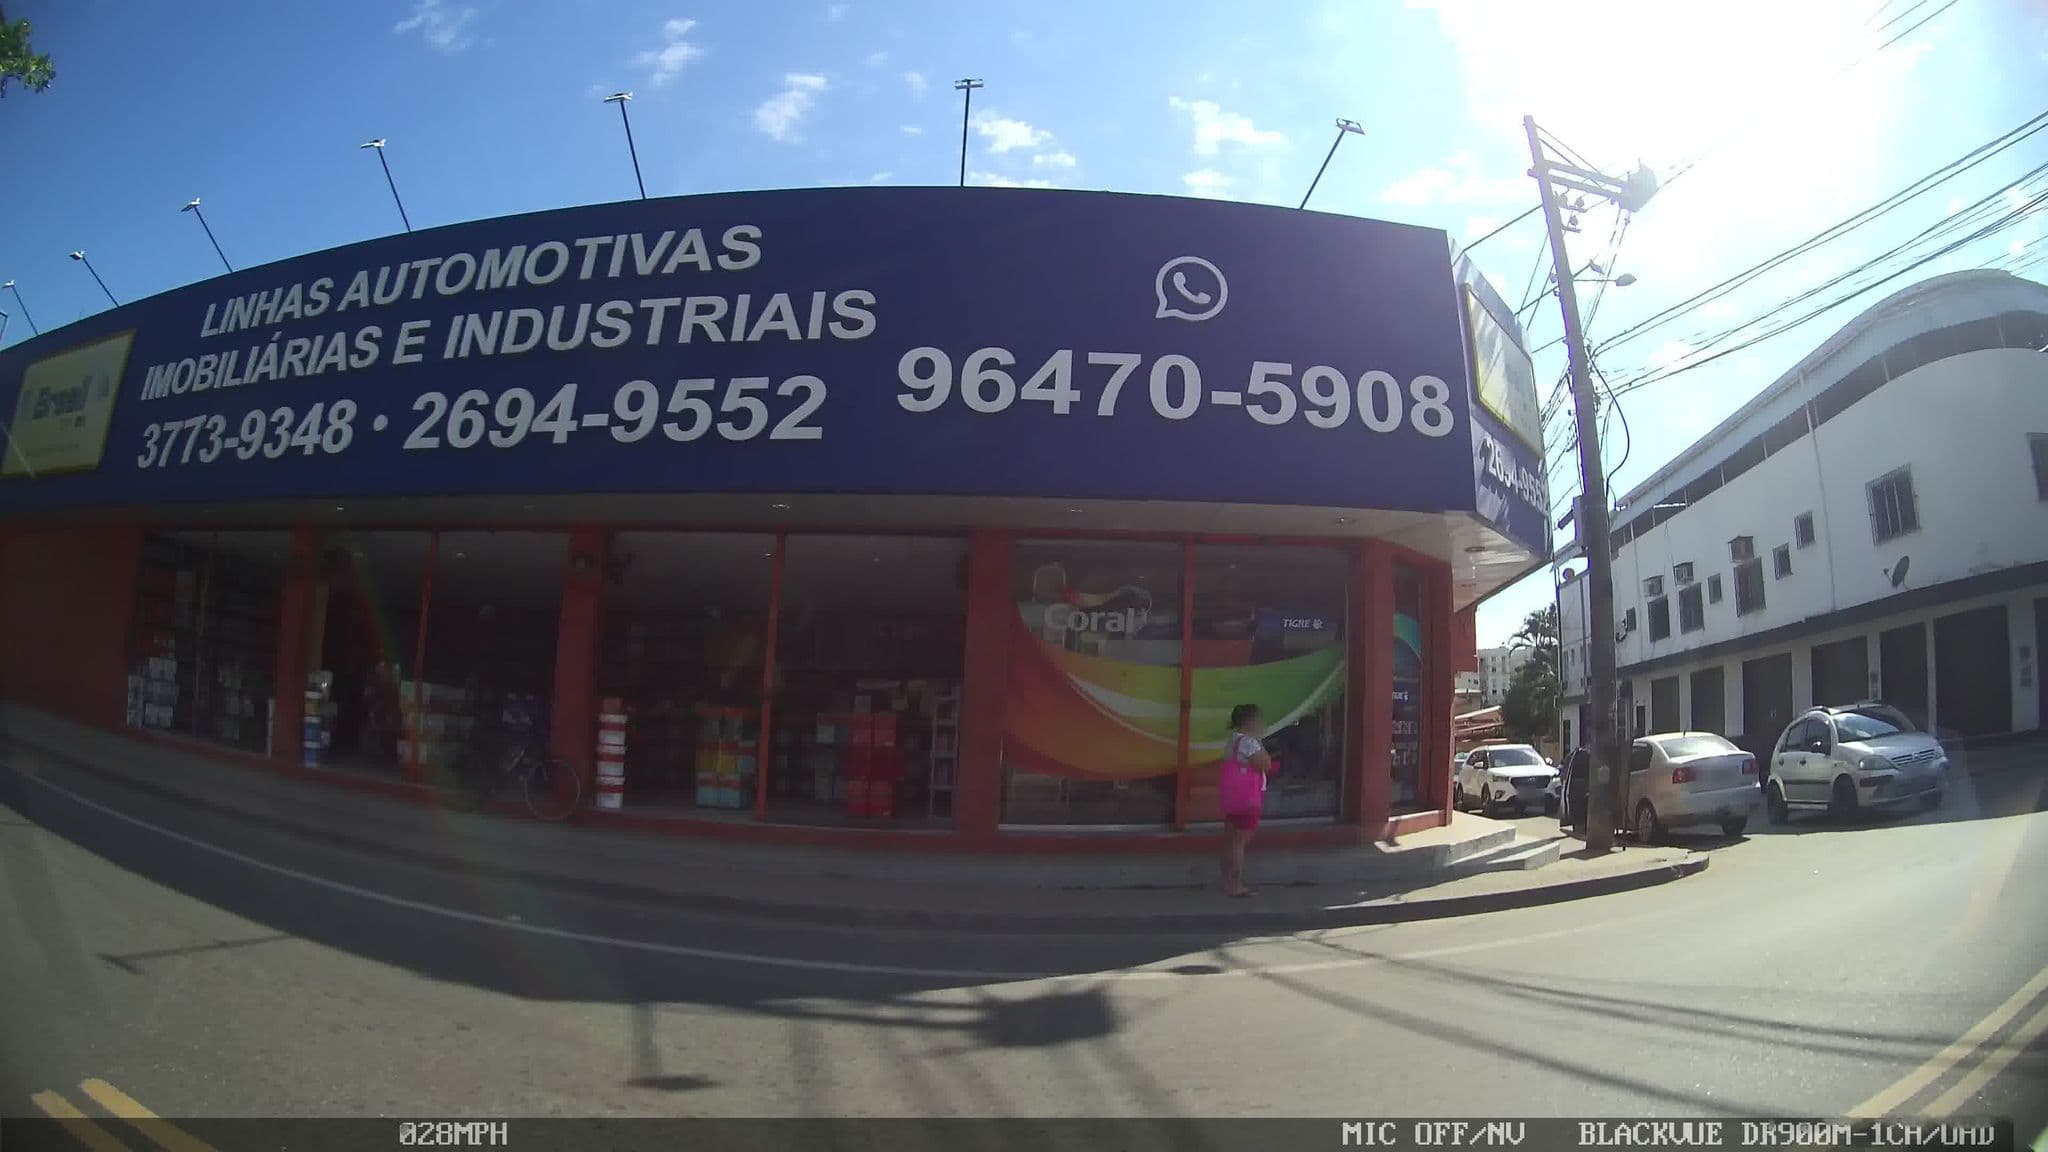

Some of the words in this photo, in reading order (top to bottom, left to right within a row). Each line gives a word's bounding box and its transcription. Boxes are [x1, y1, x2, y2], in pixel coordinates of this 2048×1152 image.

[200, 277, 333, 338] LINHAS
[337, 224, 763, 312] AUTOMOTIVAS
[140, 325, 382, 400] IMOBILIÁRIAS
[392, 319, 431, 365] E
[443, 289, 877, 360] INDUSTRIAIS
[138, 400, 357, 468] 3773-9348
[403, 375, 827, 450] 2694-9552
[897, 345, 1454, 437] 96470-5908
[1043, 606, 1138, 633] Coral
[1283, 617, 1311, 629] TIGRE
